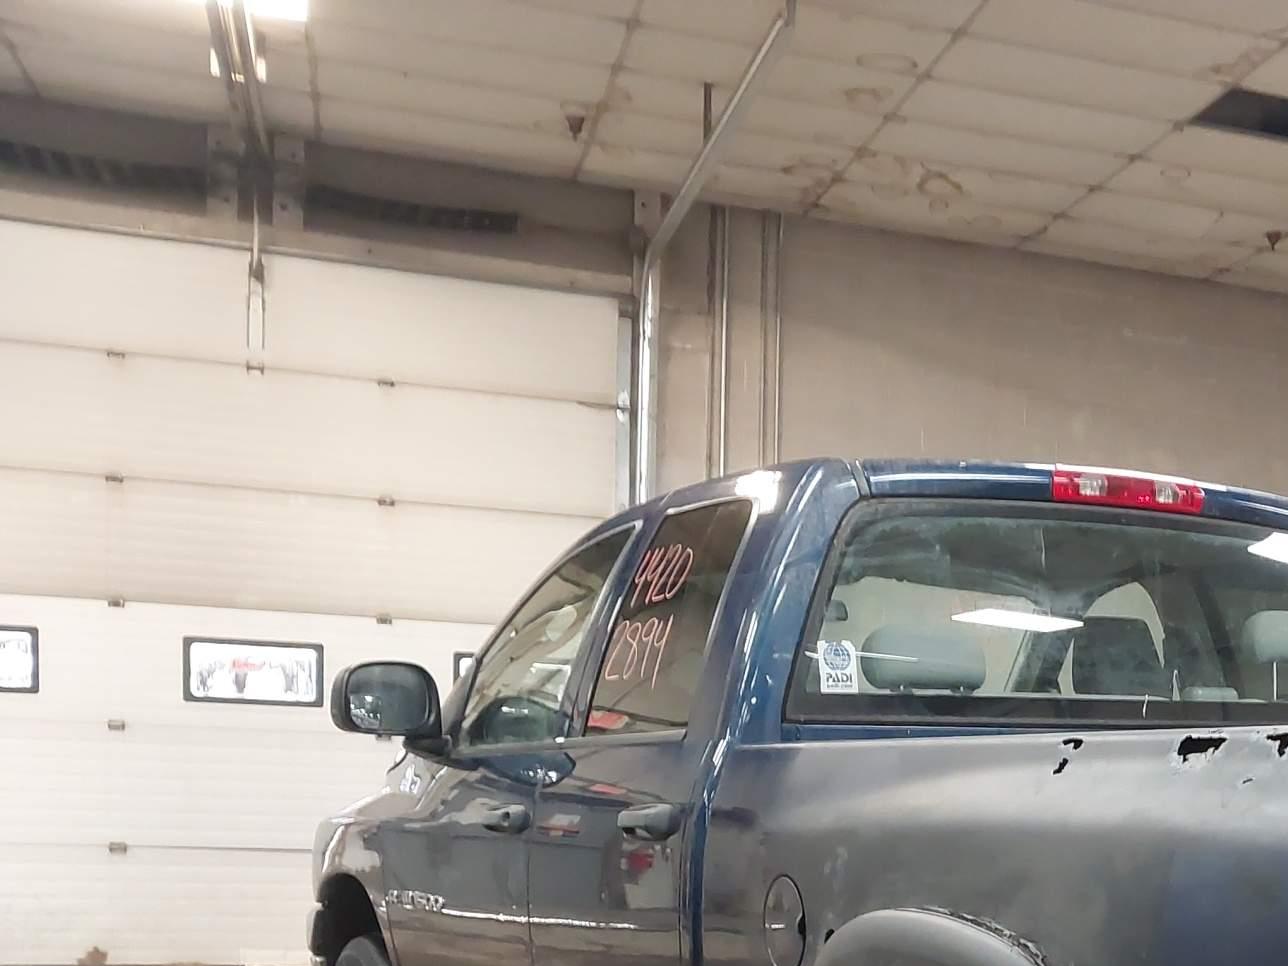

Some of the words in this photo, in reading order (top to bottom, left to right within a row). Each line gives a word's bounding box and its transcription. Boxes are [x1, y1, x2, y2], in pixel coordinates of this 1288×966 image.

[630, 543, 694, 608] 4420
[604, 614, 674, 690] 2894
[825, 672, 853, 683] PADI
